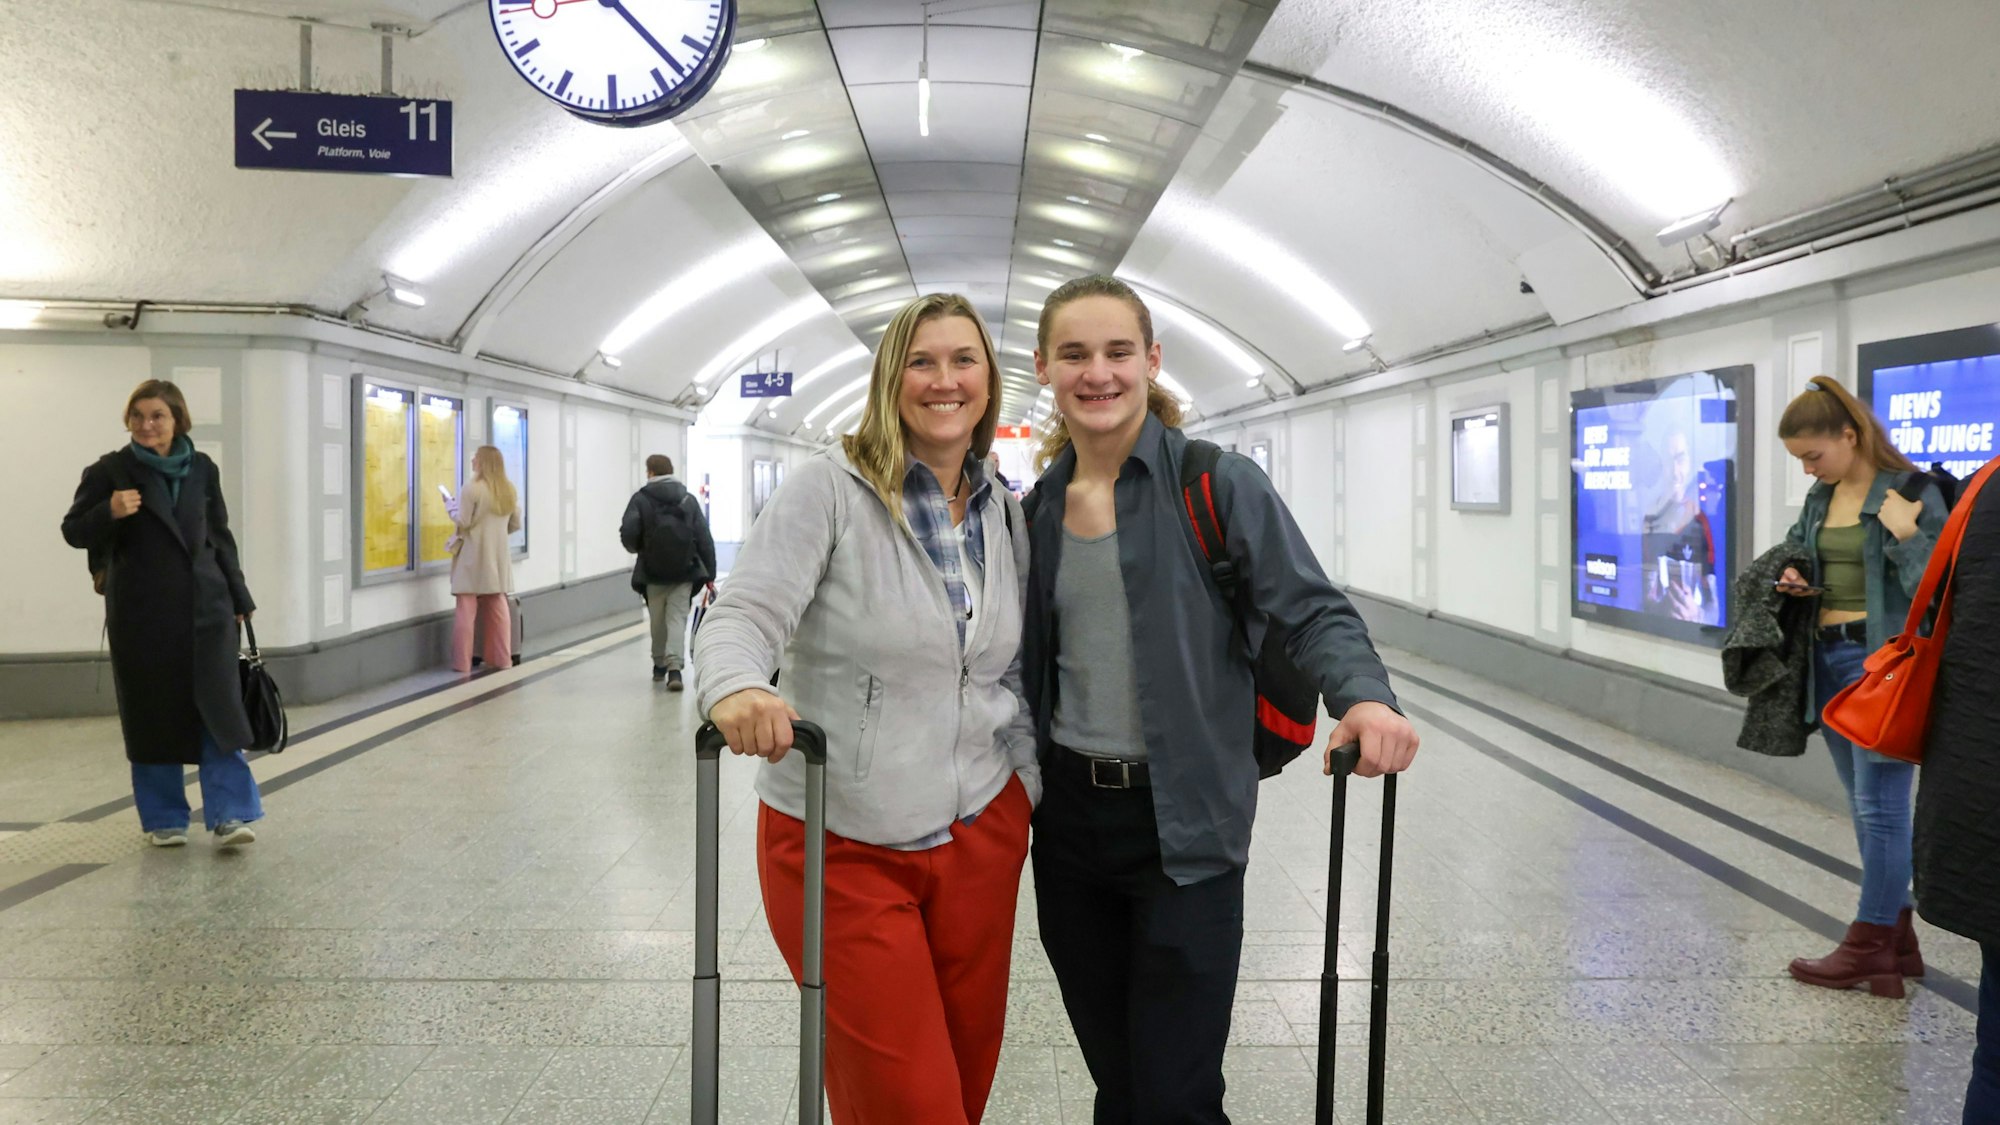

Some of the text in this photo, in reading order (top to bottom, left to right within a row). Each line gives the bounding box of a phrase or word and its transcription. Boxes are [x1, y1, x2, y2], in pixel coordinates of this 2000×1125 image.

[317, 101, 437, 142] Gleis 11
[317, 145, 391, 160] Platform, Voie
[764, 373, 785, 387] 4-5
[1888, 390, 1942, 421] NEWS
[1889, 421, 1994, 455] FÜR JUNGE
